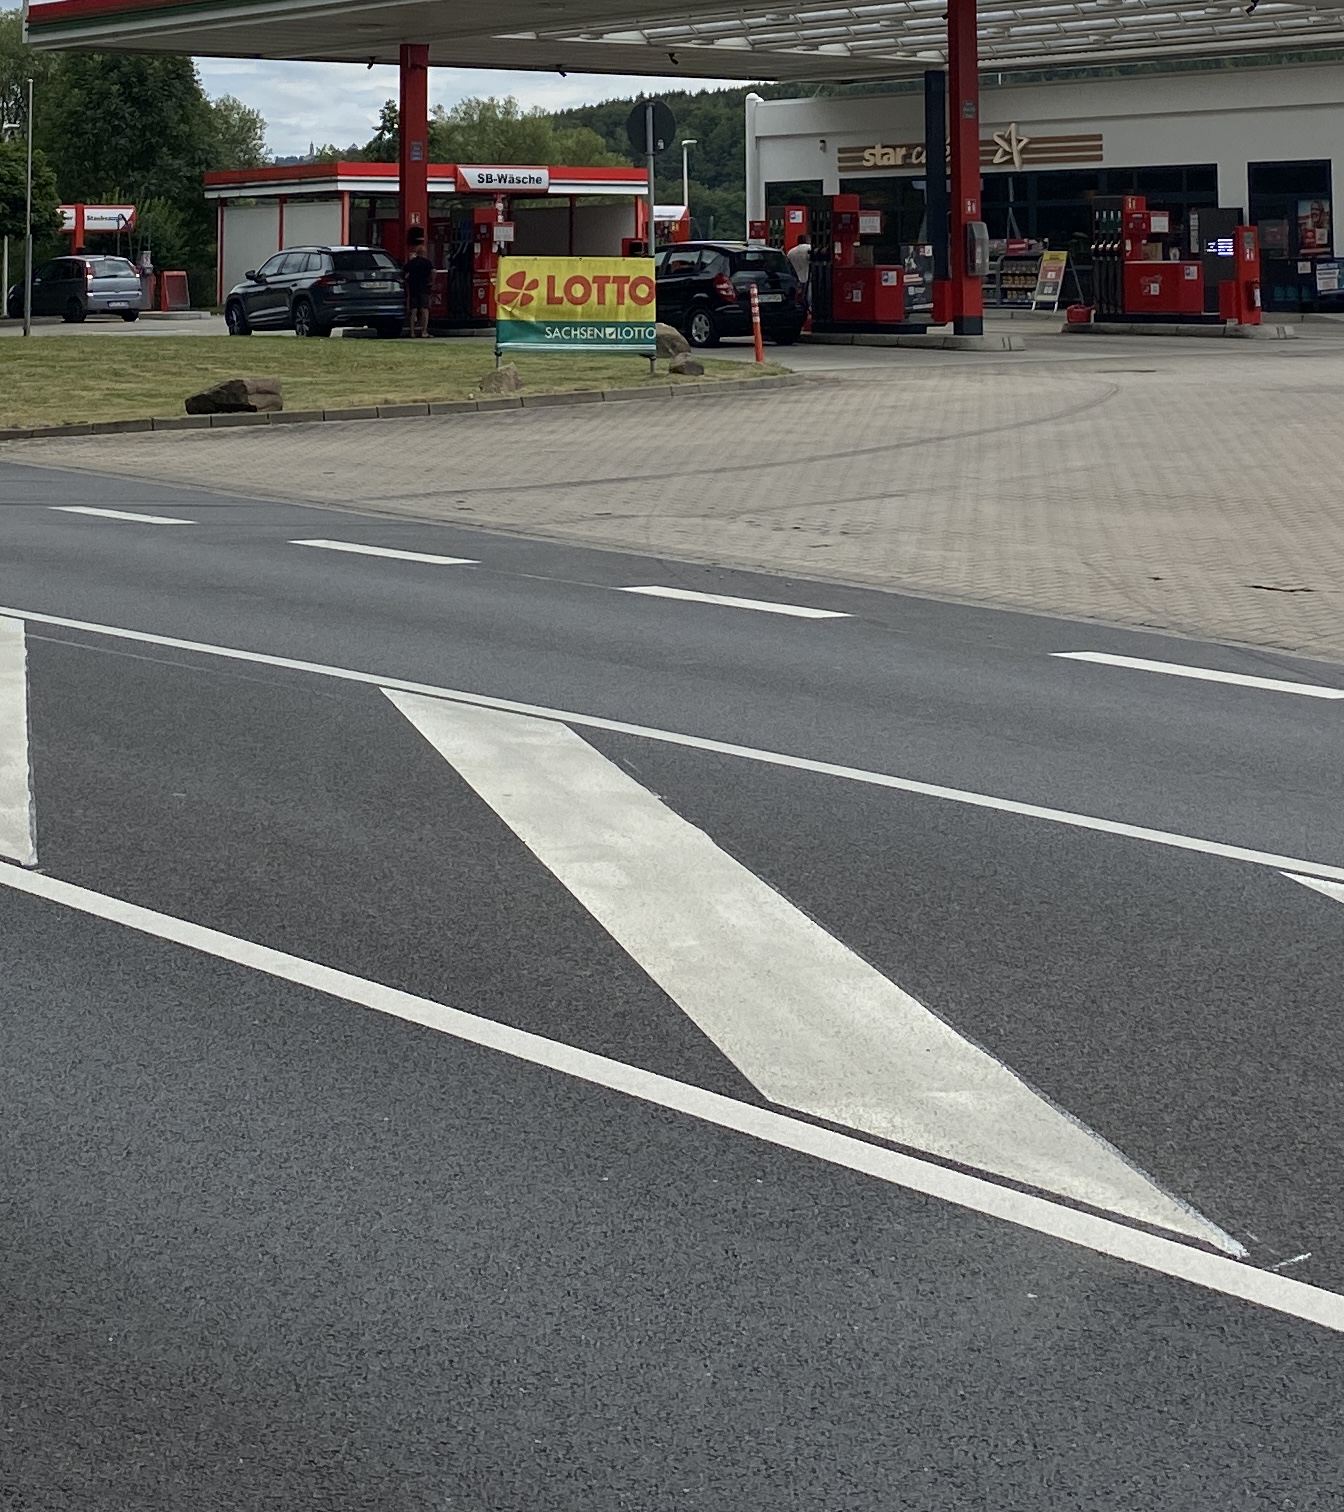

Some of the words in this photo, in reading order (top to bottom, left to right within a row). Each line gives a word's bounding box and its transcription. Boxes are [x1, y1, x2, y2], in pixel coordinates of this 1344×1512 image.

[862, 143, 907, 167] star
[477, 173, 543, 185] SB-Wäsche
[546, 275, 656, 306] LOTTO
[544, 326, 604, 339] SACHSEN
[617, 327, 656, 339] LOTTO
